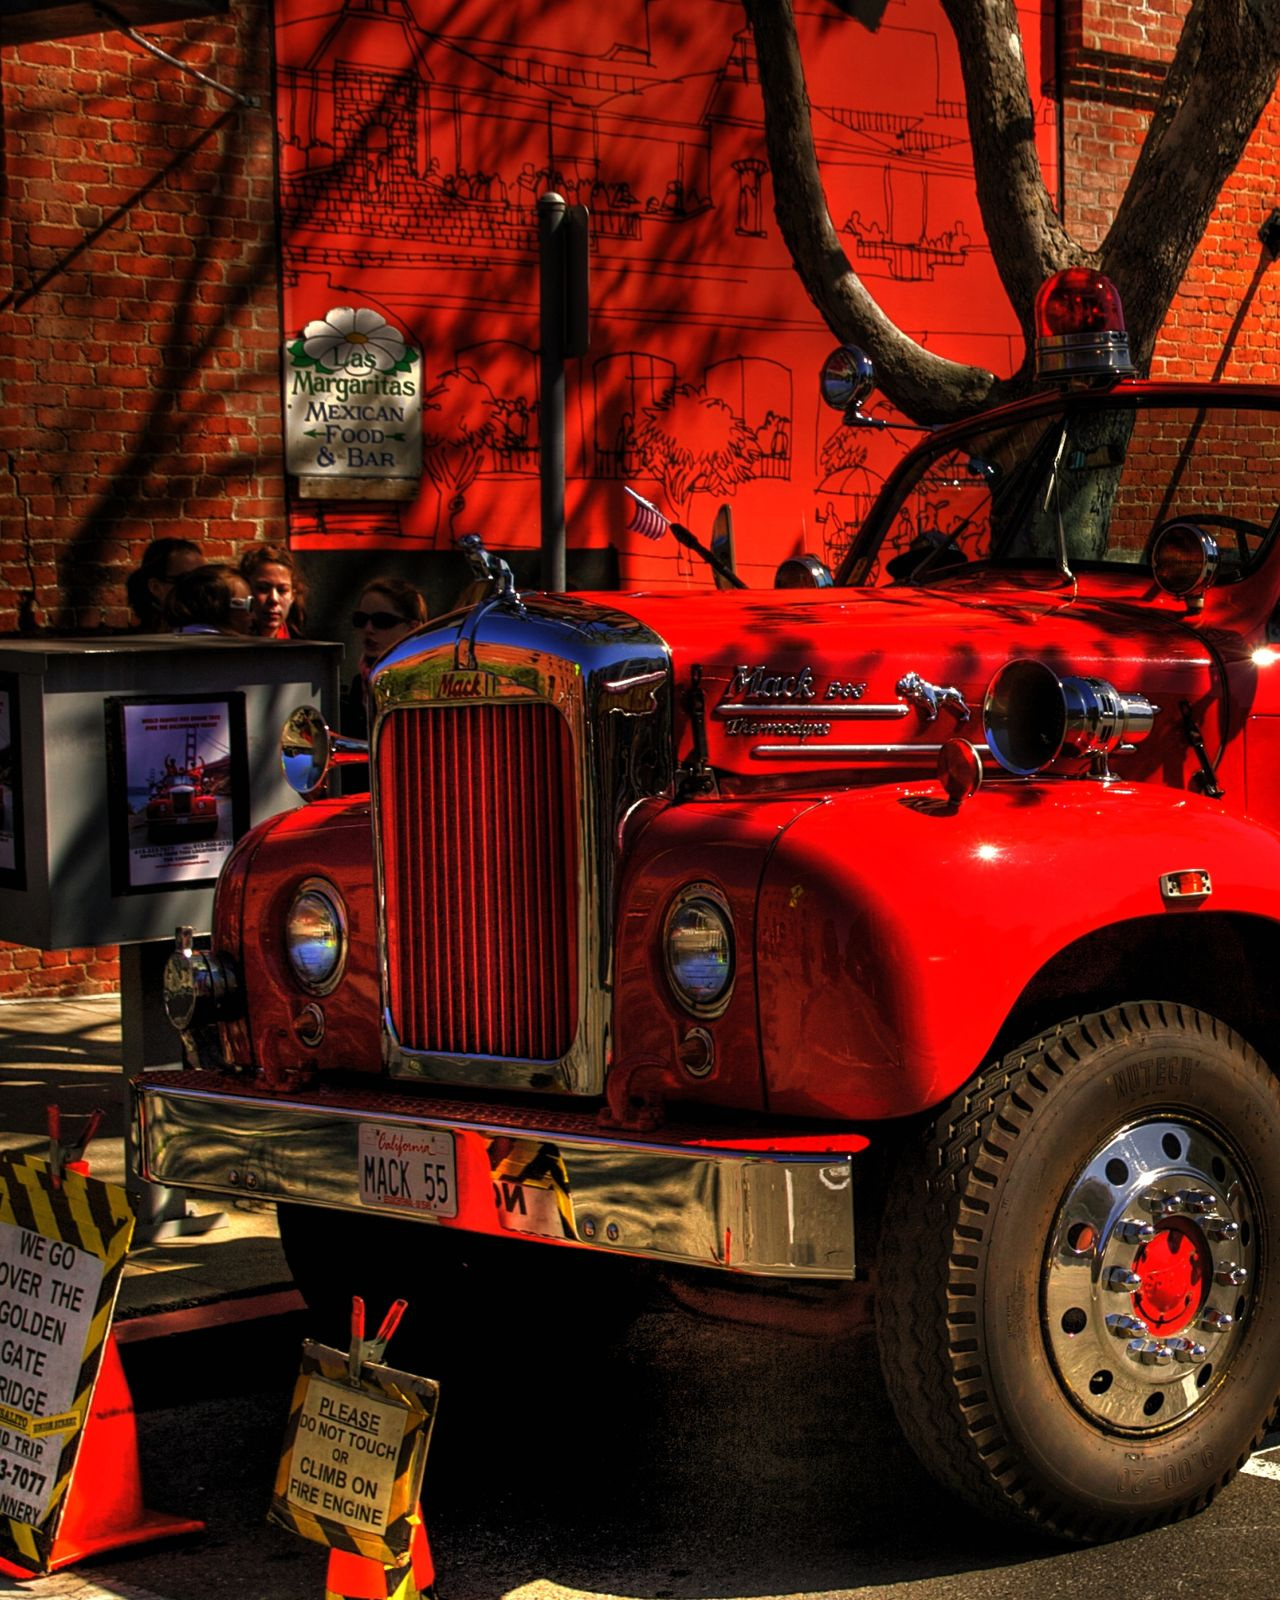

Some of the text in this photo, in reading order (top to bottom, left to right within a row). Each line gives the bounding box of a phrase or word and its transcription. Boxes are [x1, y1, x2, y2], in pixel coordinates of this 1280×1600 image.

[334, 347, 377, 368] Las
[292, 371, 416, 402] Margaritas
[304, 401, 404, 423] MEXICAN
[325, 425, 385, 444] FOOD
[317, 447, 395, 467] & BAR
[437, 673, 481, 697] Mack
[724, 665, 816, 698] Mack
[378, 1131, 434, 1157] California
[364, 1154, 449, 1204] MACK 55
[20, 1231, 75, 1270] WE GO
[50, 1279, 85, 1313] THE
[0, 1301, 67, 1345] GOLDEN
[1, 1340, 47, 1377] GATE
[319, 1396, 381, 1433] PLEASE
[15, 1435, 44, 1460] TRIP
[300, 1414, 397, 1461] DO NOT TOUCH
[332, 1448, 349, 1465] OR
[300, 1456, 378, 1500] CLIMB ON
[290, 1478, 383, 1527] FIRE ENGINE
